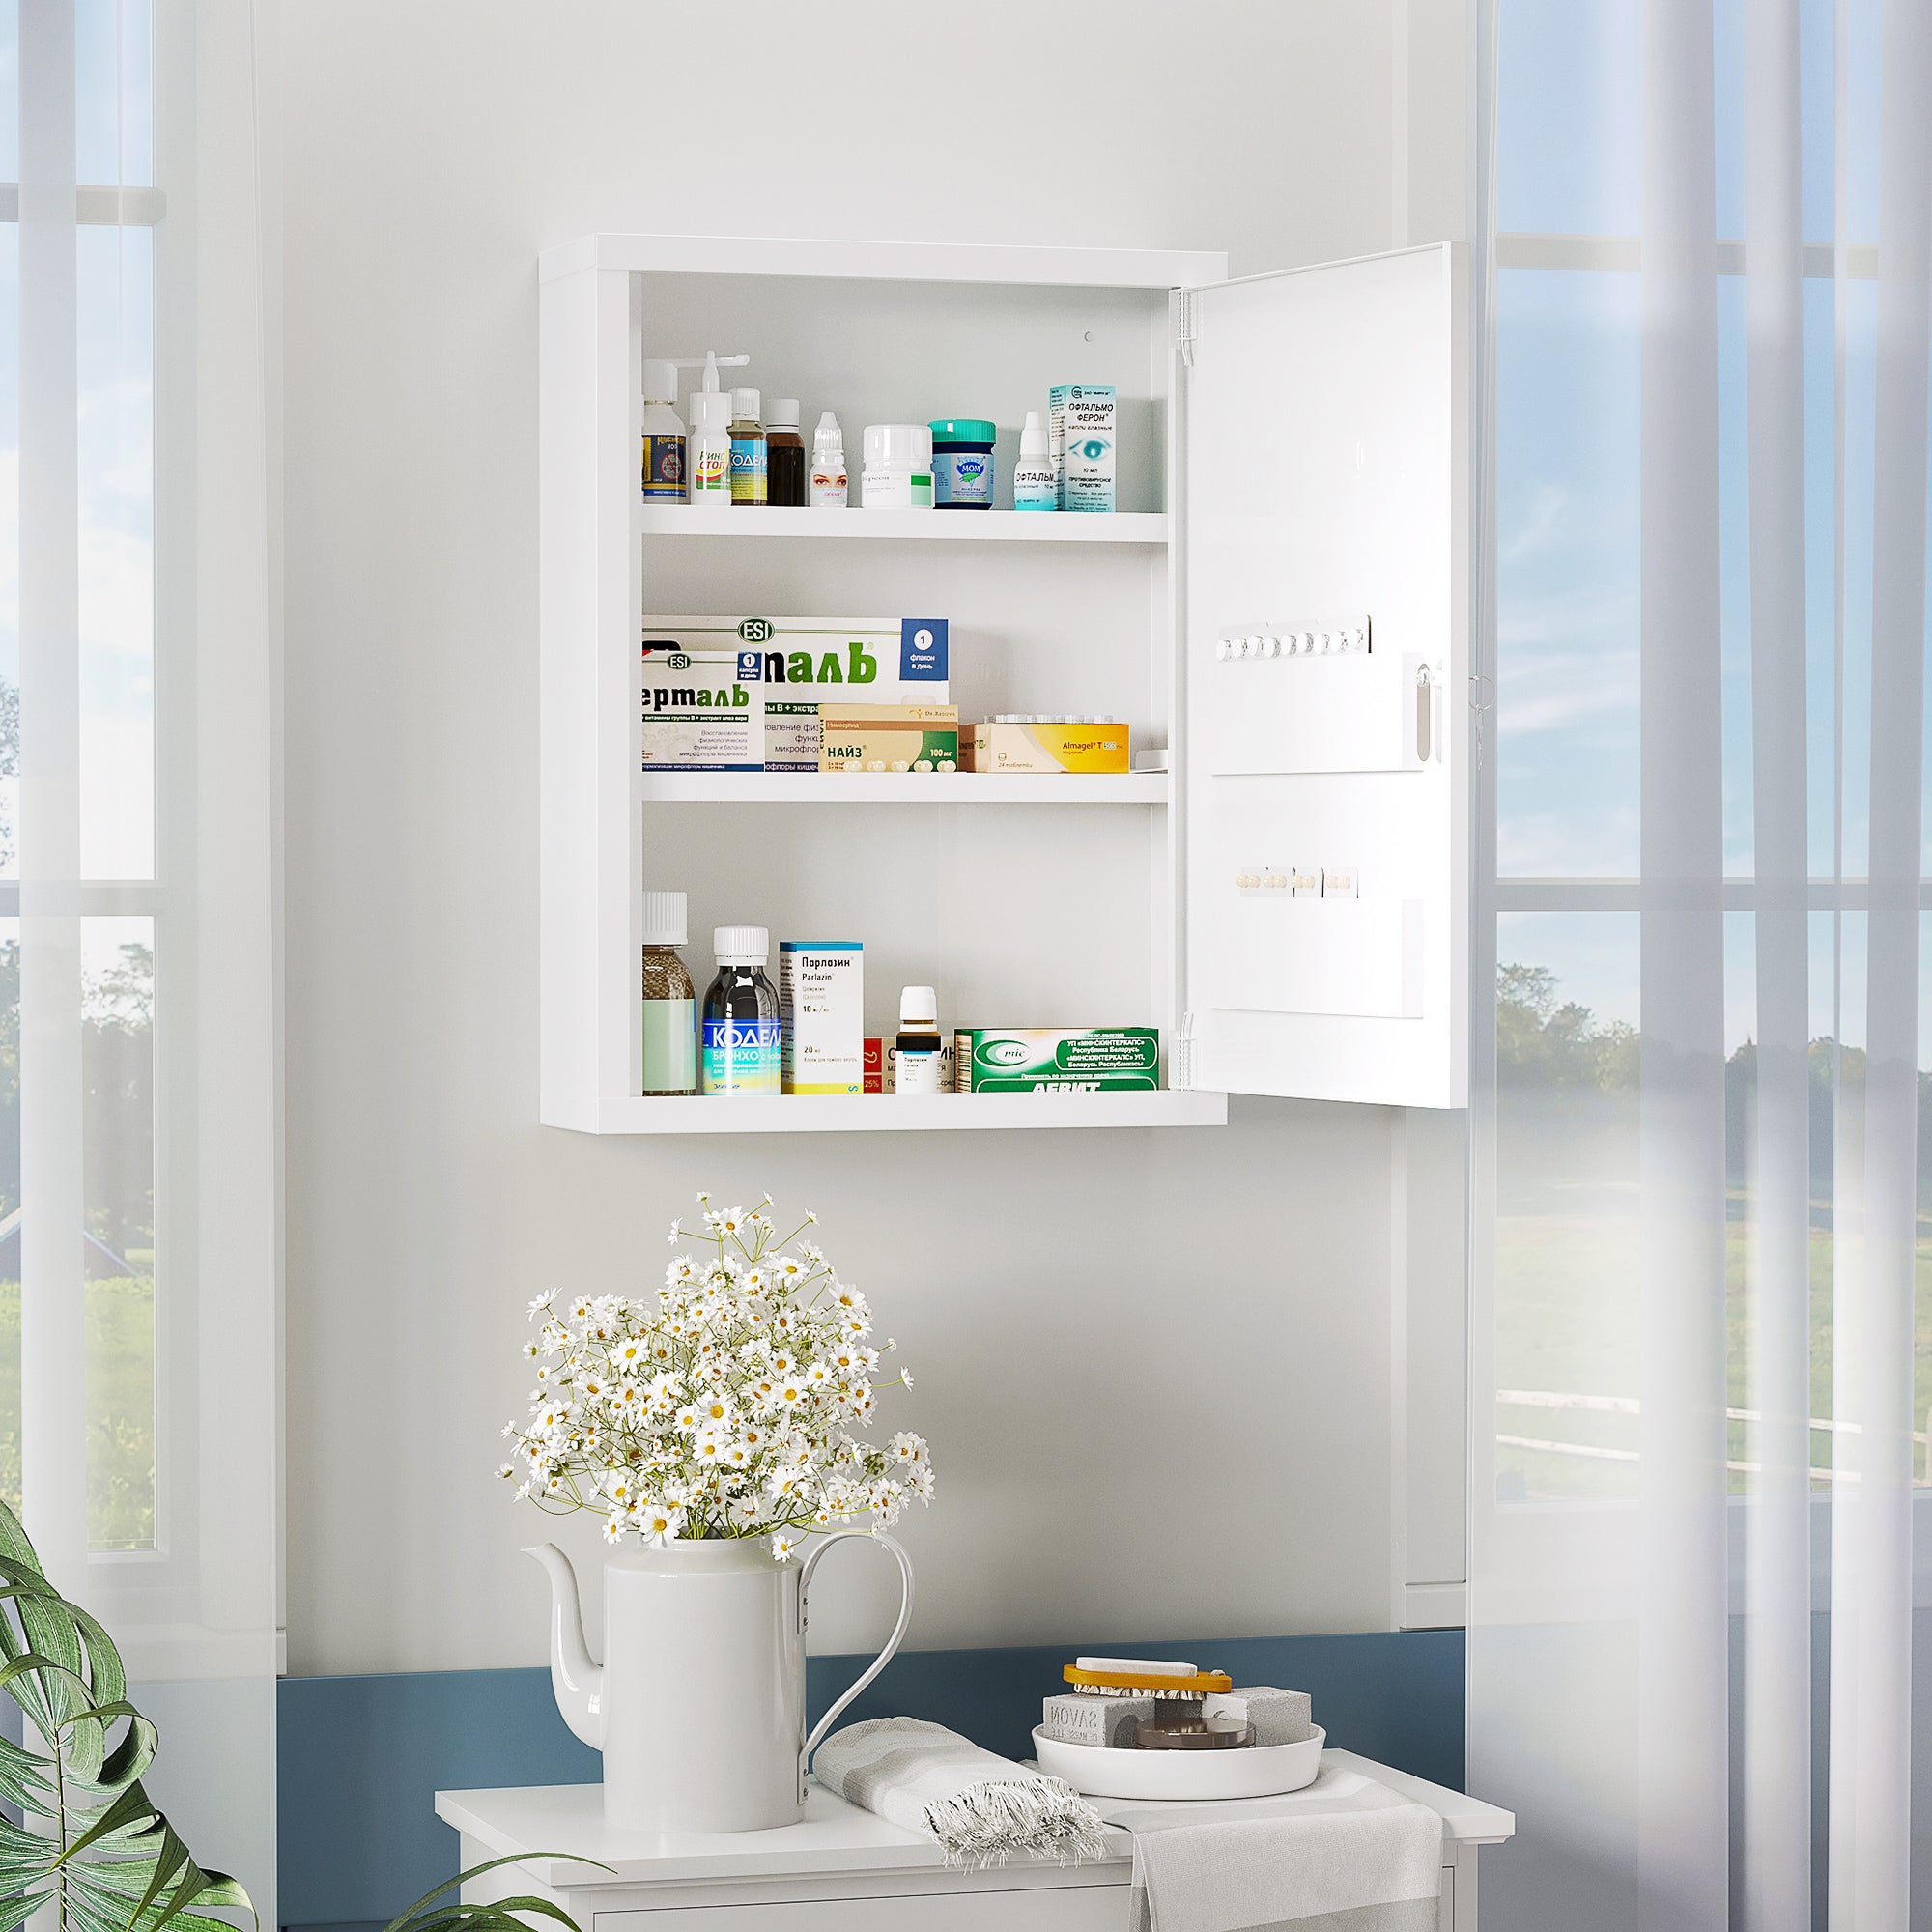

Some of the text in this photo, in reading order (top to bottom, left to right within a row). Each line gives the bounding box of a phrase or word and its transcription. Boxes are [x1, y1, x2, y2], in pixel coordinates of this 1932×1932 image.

[1068, 403, 1114, 412] ОФТАЛЬМО
[731, 455, 767, 466] ОДЕЛ
[744, 622, 770, 639] ESI
[921, 635, 925, 644] 1
[670, 656, 688, 668] ESI
[828, 745, 862, 757] НАЙЗ
[1063, 742, 1094, 751] Almagel
[930, 749, 943, 757] 100
[1004, 1048, 1026, 1058] mic
[865, 1079, 880, 1088] 25%
